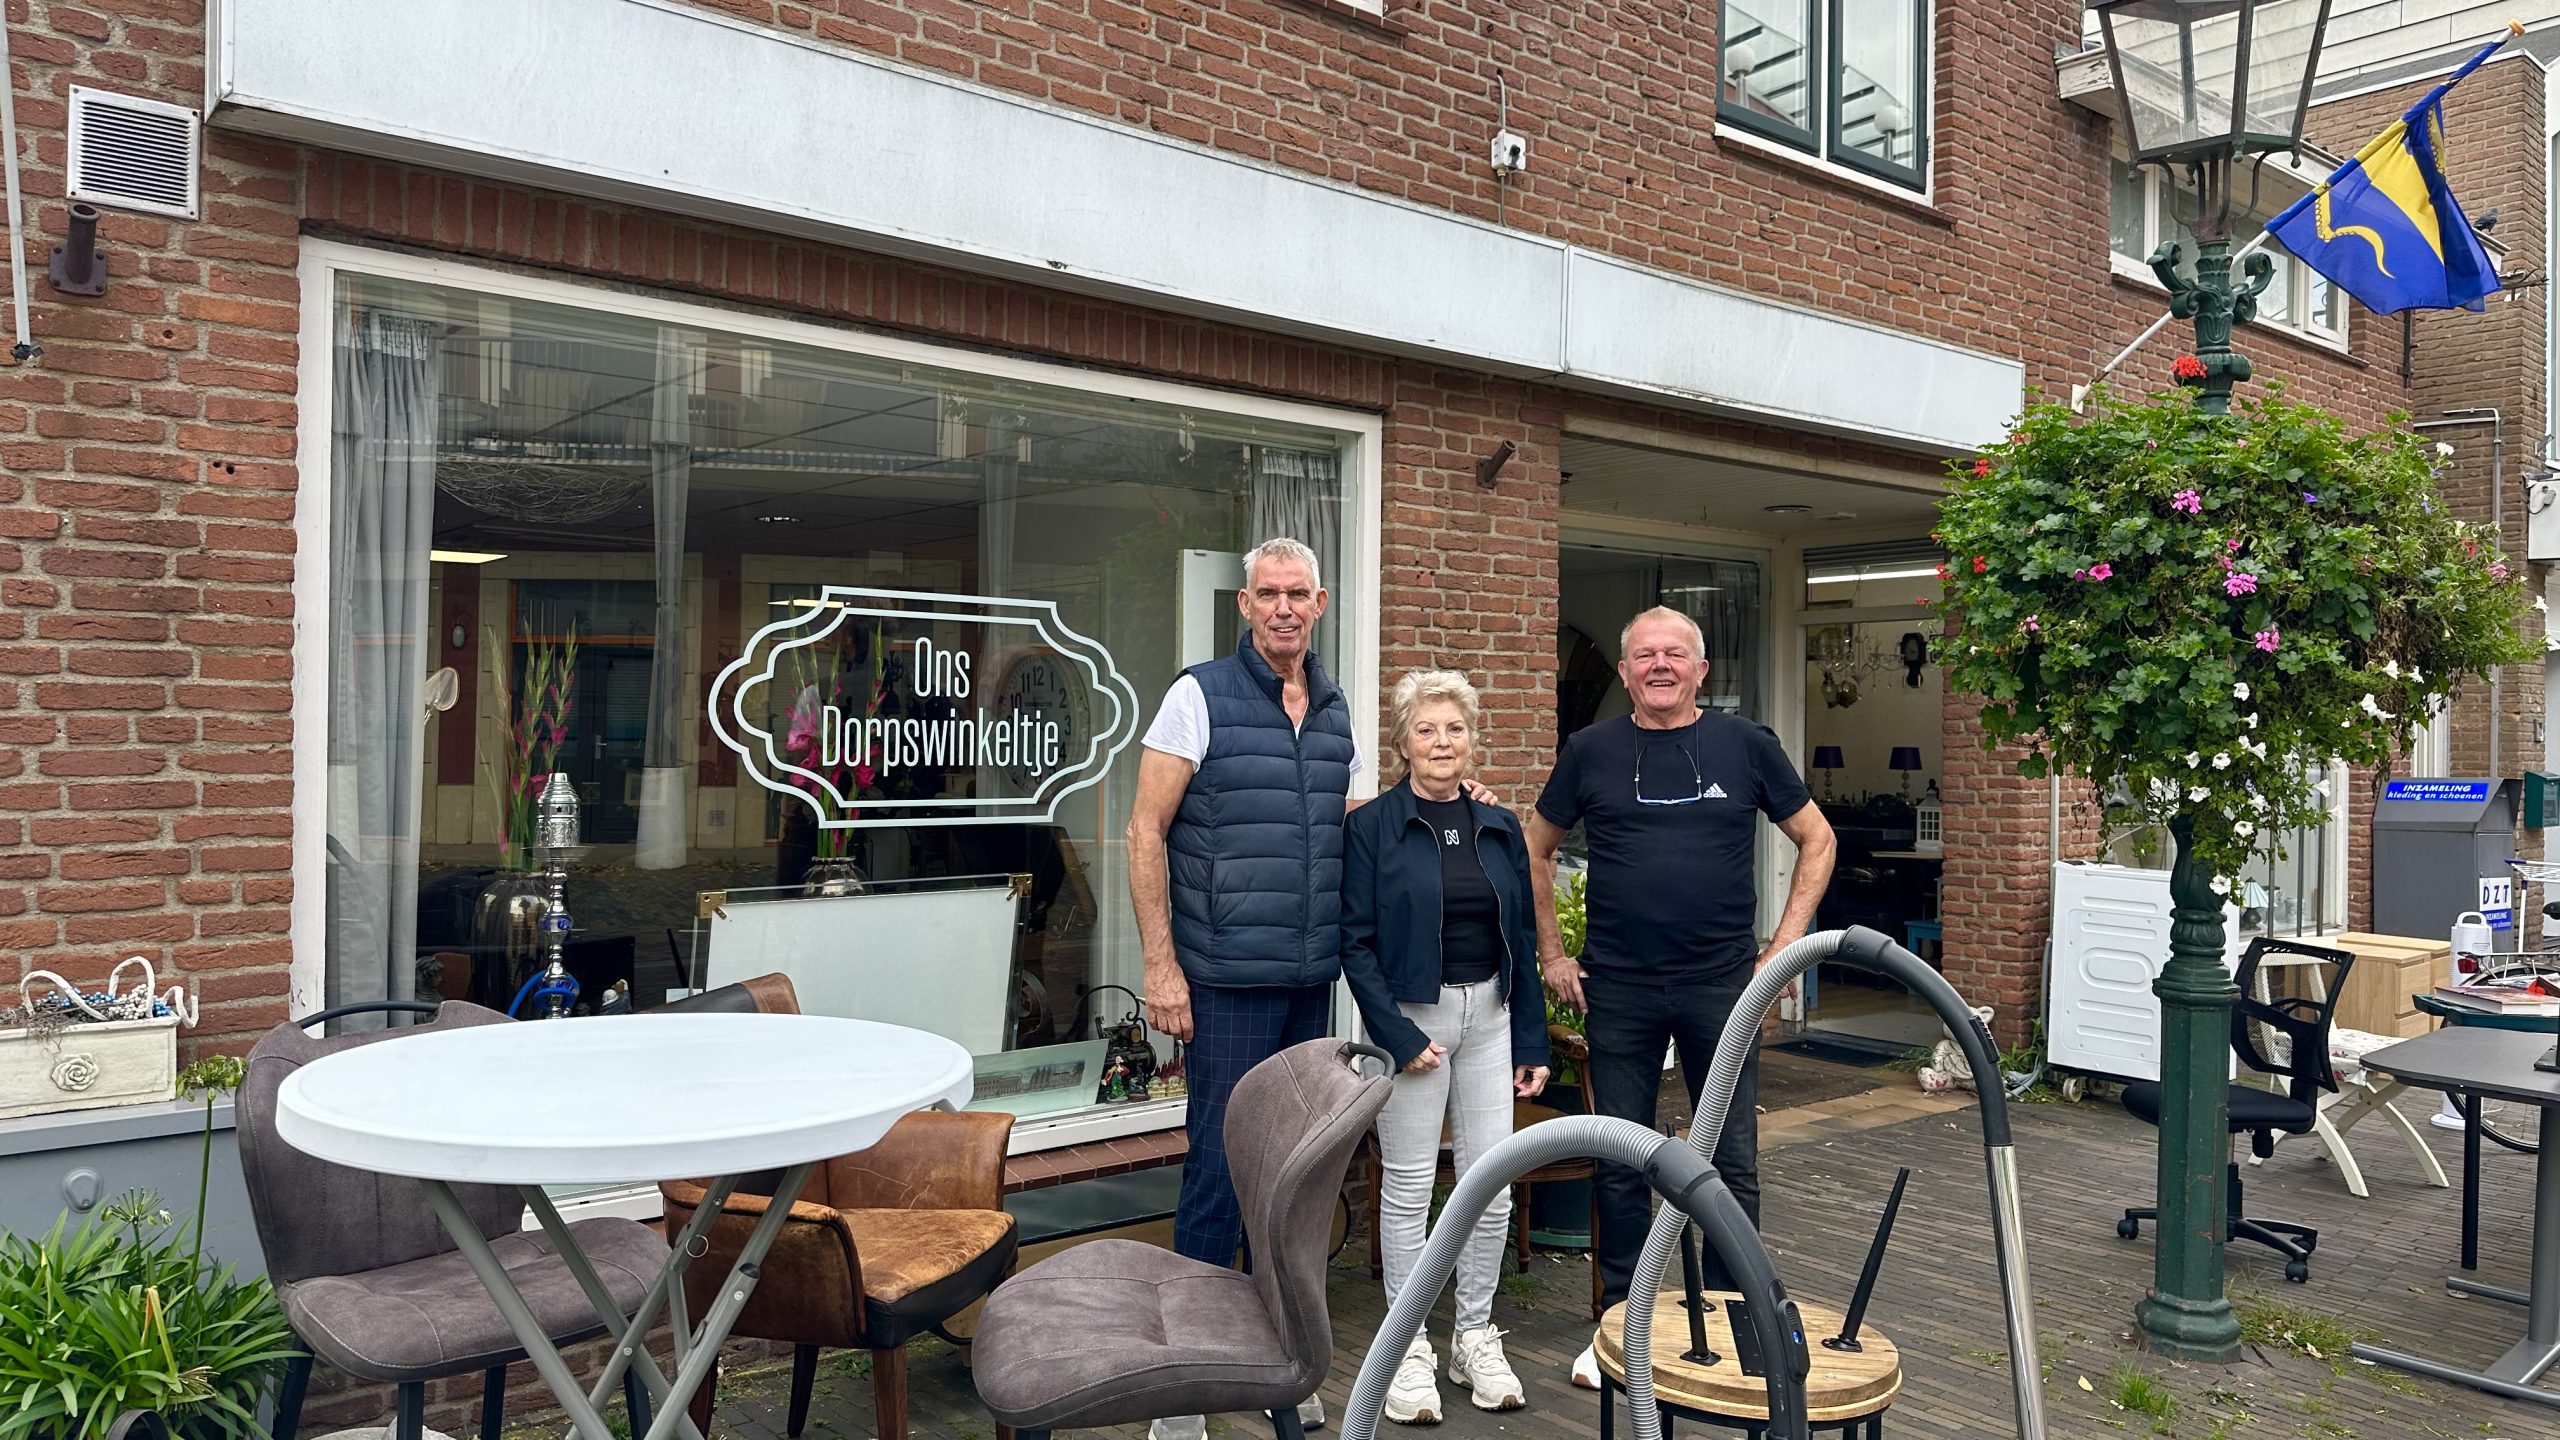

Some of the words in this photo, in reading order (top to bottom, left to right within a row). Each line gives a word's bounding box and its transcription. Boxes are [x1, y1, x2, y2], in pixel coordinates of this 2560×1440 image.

[914, 636, 971, 699] Ons
[1032, 665, 1045, 686] 12
[1021, 672, 1031, 693] 11
[1050, 671, 1054, 692] 1
[1059, 688, 1067, 708] 2
[1064, 715, 1071, 736] 3
[821, 705, 1059, 777] Dorpswinkeltje
[1058, 741, 1067, 762] 4
[2387, 791, 2422, 800] kleding
[2402, 784, 2472, 792] INZAMELING
[1444, 829, 1460, 845] N
